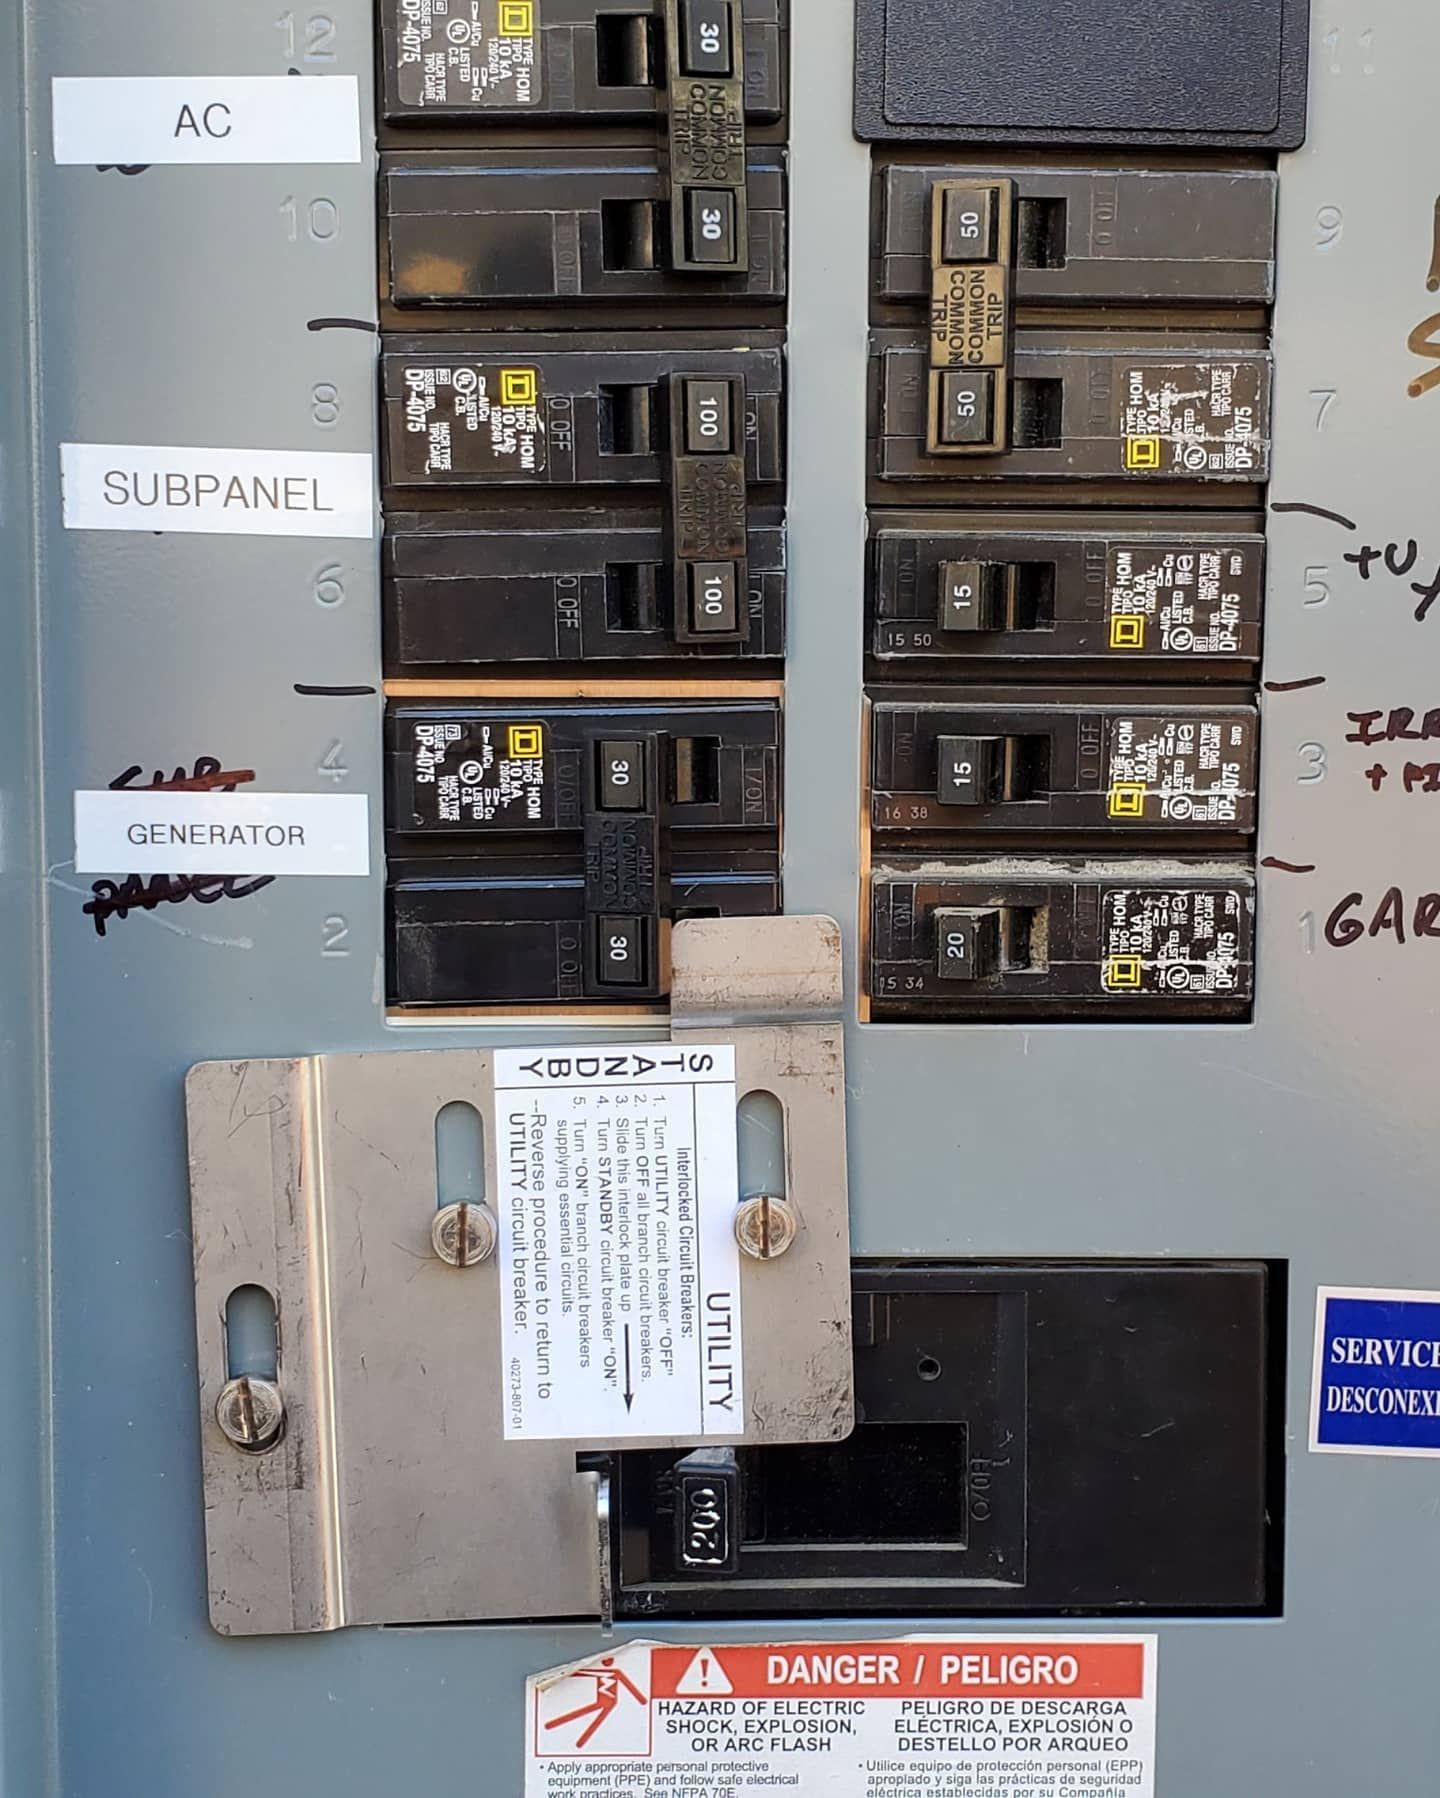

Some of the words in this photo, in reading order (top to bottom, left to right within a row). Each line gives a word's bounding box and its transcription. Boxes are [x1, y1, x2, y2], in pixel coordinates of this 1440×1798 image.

[275, 9, 336, 63] 12
[700, 22, 720, 54] 30
[516, 68, 530, 102] HOM
[174, 102, 232, 138] AC
[279, 194, 339, 242] 10
[702, 208, 722, 240] 30
[960, 212, 978, 238] 50
[1315, 204, 1344, 251] 9
[949, 271, 965, 366] COMMON
[969, 270, 985, 364] COMMON
[988, 292, 1002, 341] TRIP
[312, 382, 340, 427] 8
[405, 369, 426, 432] DP-4075
[958, 392, 976, 417] 50
[1130, 372, 1142, 404] HOM
[700, 397, 717, 436] 100
[1309, 388, 1337, 431] 7
[520, 434, 534, 468] HOM
[103, 470, 335, 512] SUBPANEL
[313, 561, 345, 609] 6
[1116, 552, 1132, 586] HOM
[704, 576, 722, 615] 100
[952, 584, 972, 610] 15
[1303, 565, 1332, 608] 5
[912, 633, 933, 647] 50
[1221, 594, 1240, 652] DP-4075
[1118, 720, 1133, 755] HOM
[317, 738, 348, 783] 4
[522, 759, 533, 782] TIPO
[532, 759, 544, 785] TYPE
[611, 760, 630, 785] 30
[953, 761, 972, 788] 15
[1297, 741, 1327, 784] 3
[438, 776, 449, 795] TIPO
[528, 786, 540, 818] HOM
[439, 796, 449, 819] CARR
[449, 800, 459, 821] TYPE
[472, 787, 482, 819] LISTED
[883, 806, 902, 821] 16
[909, 806, 929, 820] 38
[126, 823, 306, 847] GENERATOR
[1111, 894, 1128, 926] HOM
[320, 916, 351, 958] 2
[610, 936, 628, 961] 30
[947, 932, 965, 959] 20
[1298, 909, 1316, 955] 1
[519, 1053, 713, 1079] STANDBY
[572, 1096, 586, 1109] 5.
[596, 1096, 610, 1108] 4.
[614, 1095, 628, 1107] 3.
[634, 1094, 647, 1108] 2.
[652, 1095, 666, 1106] 1.
[574, 1118, 588, 1152] Turn
[597, 1118, 610, 1151] Turn
[616, 1117, 630, 1154] Slide
[634, 1116, 648, 1150] Turn
[654, 1116, 667, 1150] Turn
[510, 1112, 528, 1190] UTILITY
[554, 1119, 570, 1188] supplying
[617, 1158, 631, 1184] this
[636, 1155, 650, 1187] OFF
[655, 1155, 669, 1216] UTILITY
[676, 1148, 693, 1221] Interlocked
[598, 1156, 613, 1235] STANDBY
[636, 1192, 650, 1208] all
[512, 1198, 530, 1252] circuit
[560, 1193, 573, 1256] essential
[576, 1202, 590, 1252] branch
[618, 1188, 633, 1249] interlock
[530, 1198, 552, 1292] procedure
[636, 1213, 650, 1262] branch
[656, 1221, 670, 1264] circuit
[678, 1226, 694, 1271] Circuit
[600, 1240, 615, 1282] circuit
[616, 1254, 633, 1289] plate
[560, 1262, 574, 1316] circuits.
[578, 1257, 592, 1300] circuit
[638, 1268, 652, 1310] circuit
[658, 1268, 671, 1322] breaker
[513, 1258, 530, 1334] breaker.
[536, 1298, 551, 1314] to
[618, 1294, 631, 1312] up
[680, 1274, 695, 1338] Breakers:
[602, 1287, 616, 1343] breaker
[537, 1322, 553, 1375] return
[578, 1304, 592, 1368] breakers
[640, 1315, 653, 1382] breakers.
[706, 1292, 733, 1412] UTILITY
[510, 1357, 522, 1430] 40273-807-01
[538, 1382, 553, 1399] to
[767, 1655, 900, 1685] DANGER
[912, 1655, 926, 1685] /
[940, 1655, 1079, 1685] PELIGRO
[658, 1701, 736, 1715] HAZARD
[742, 1701, 767, 1715] OF
[774, 1701, 866, 1715] ELECTRIC
[894, 1716, 1002, 1734] ELÉCTRICA,
[1008, 1716, 1113, 1733] EXPLOSIÓN
[1119, 1719, 1133, 1733] O
[901, 1701, 984, 1715] PELIGRO
[990, 1701, 1014, 1715] DE
[1022, 1701, 1127, 1715] DESCARGA
[666, 1720, 737, 1735] SHOCK,
[744, 1720, 857, 1735] EXPLOSION,
[898, 1737, 996, 1751] DESTELLO
[1002, 1737, 1042, 1751] POR
[1047, 1737, 1129, 1751] ARQUEO
[692, 1738, 719, 1752] OR
[724, 1738, 764, 1752] ARC
[770, 1738, 831, 1752] FLASH
[547, 1762, 581, 1773] Apply
[584, 1762, 652, 1773] appropriate
[656, 1762, 708, 1773] personal
[712, 1762, 768, 1773] protective
[548, 1774, 610, 1786] equipment
[615, 1774, 651, 1786] (PPE)
[654, 1774, 676, 1784] and
[680, 1774, 714, 1784] follow
[717, 1774, 744, 1784] safe
[747, 1774, 799, 1784] electrical
[866, 1760, 906, 1772] Utilice
[909, 1761, 953, 1774] equipo
[956, 1760, 972, 1772] de
[976, 1759, 1042, 1774] protección
[1046, 1760, 1102, 1774] personal
[1105, 1760, 1144, 1773] (EPP)
[868, 1774, 931, 1787] apropiado
[934, 1776, 942, 1788] y
[946, 1774, 972, 1787] siga
[976, 1774, 995, 1784] las
[998, 1774, 1056, 1787] prácticas
[1060, 1774, 1076, 1784] de
[1079, 1774, 1142, 1787] seguridad
